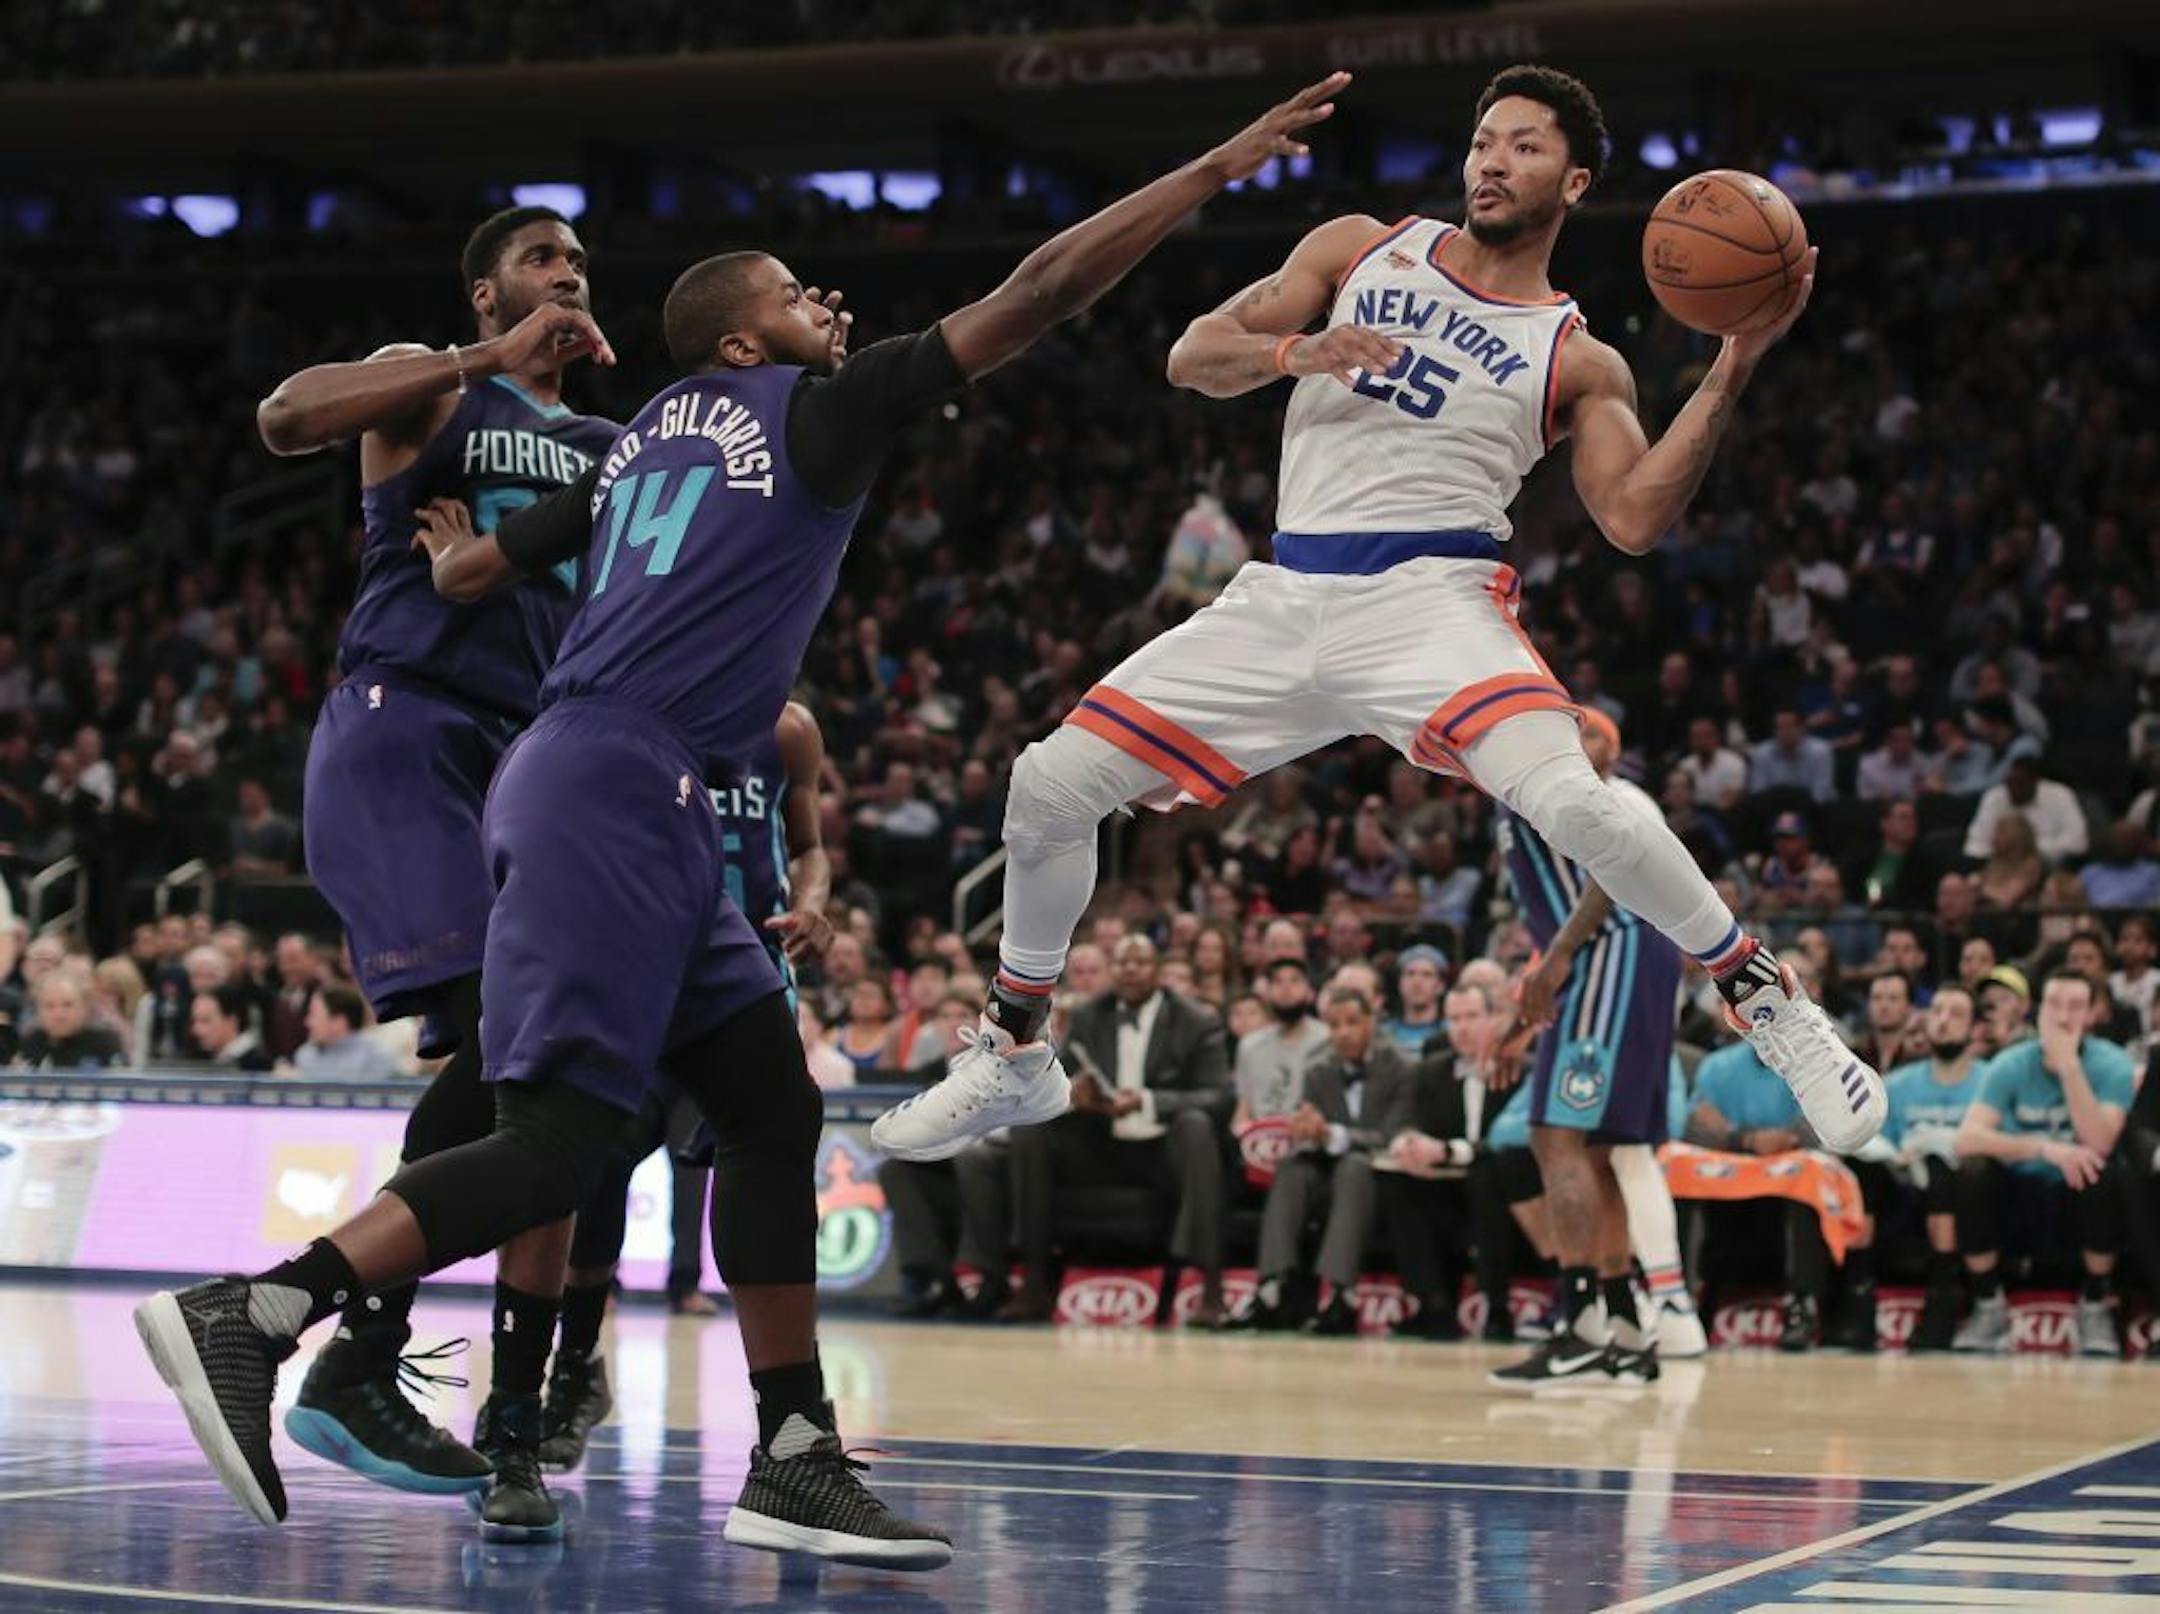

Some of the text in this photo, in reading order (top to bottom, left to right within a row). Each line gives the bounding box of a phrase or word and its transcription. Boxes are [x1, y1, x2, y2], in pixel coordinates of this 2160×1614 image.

[1070, 45, 1264, 82] LEXUS
[1327, 26, 1541, 67] SUITE LEVEL
[1354, 289, 1530, 387] NEW YORK
[1352, 345, 1459, 419] 25
[464, 429, 595, 485] HORNET
[592, 465, 718, 599] 14
[1076, 1287, 1138, 1317] KIA
[2010, 1312, 2079, 1346] KIA
